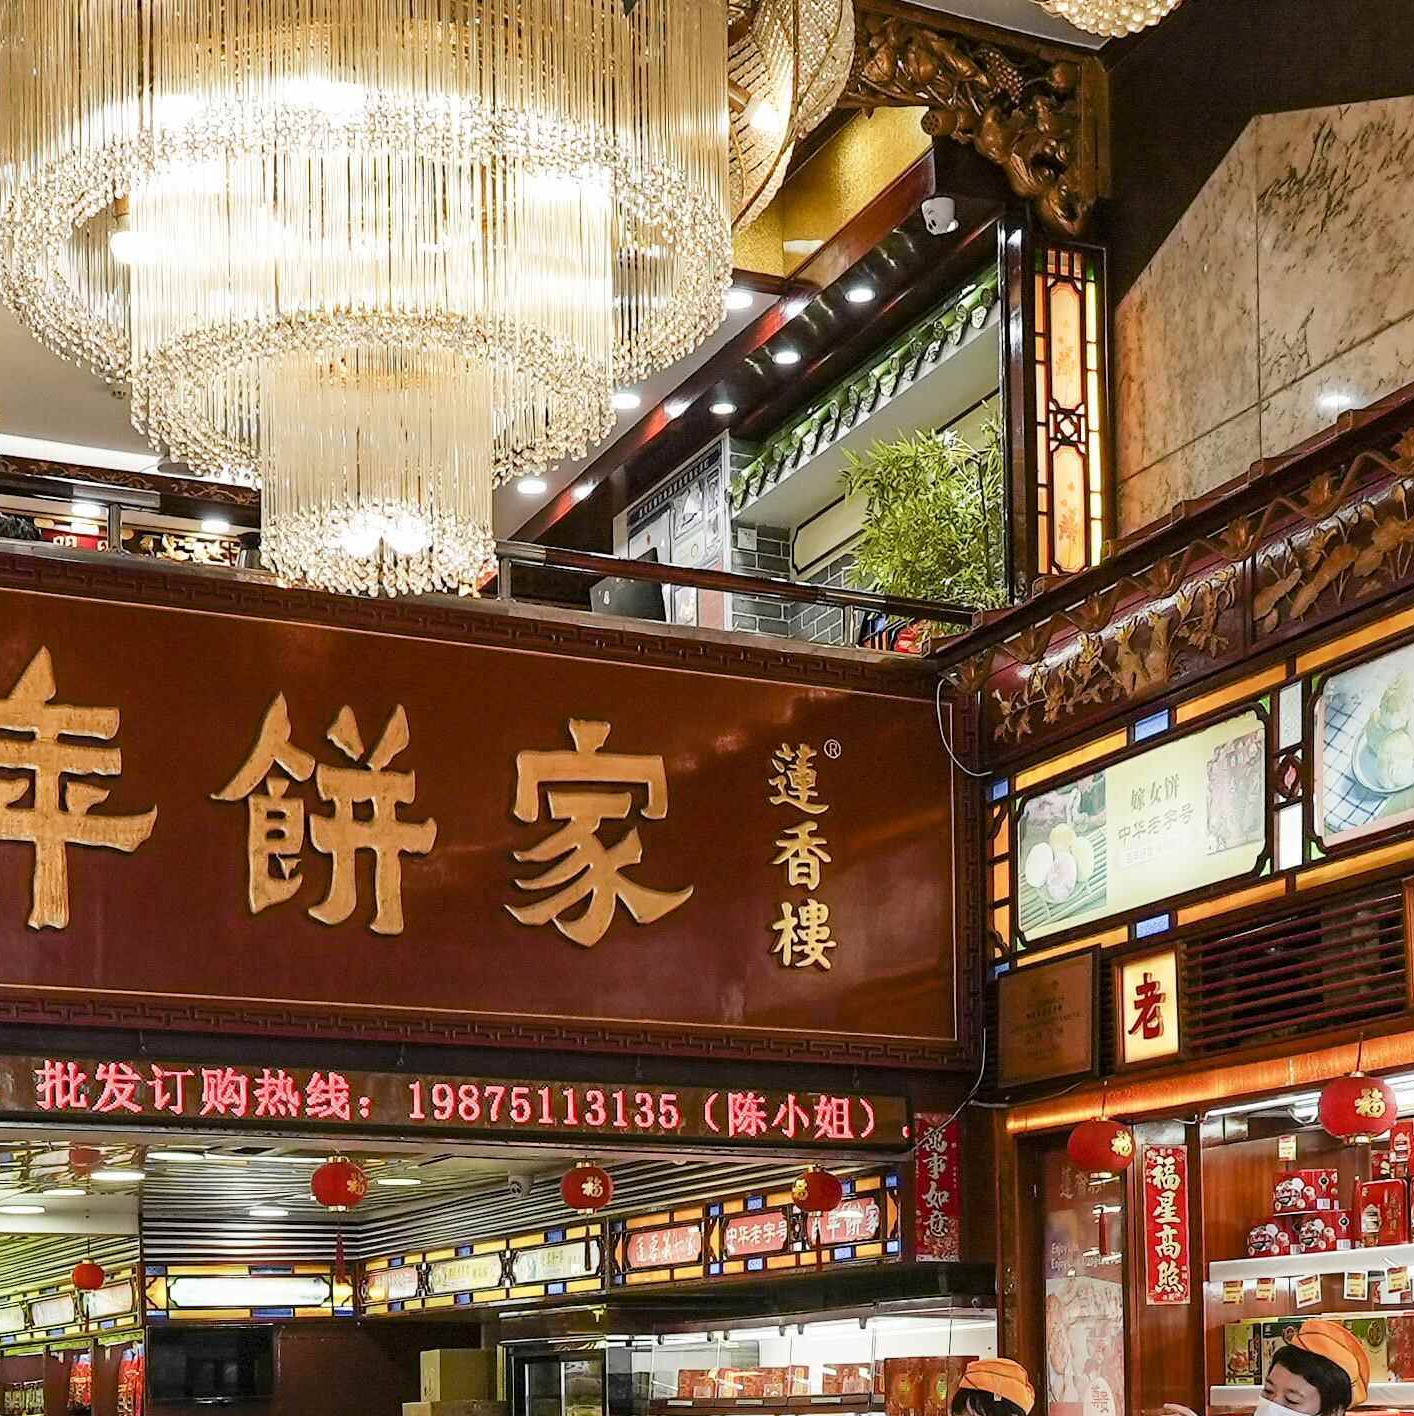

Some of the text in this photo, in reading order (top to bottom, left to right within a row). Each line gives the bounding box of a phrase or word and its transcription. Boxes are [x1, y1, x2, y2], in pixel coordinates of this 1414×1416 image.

[767, 743, 837, 970] 蓮香樓
[1128, 972, 1166, 1040] 老
[1354, 1087, 1386, 1118] 福
[1150, 1155, 1186, 1295] 福星高照
